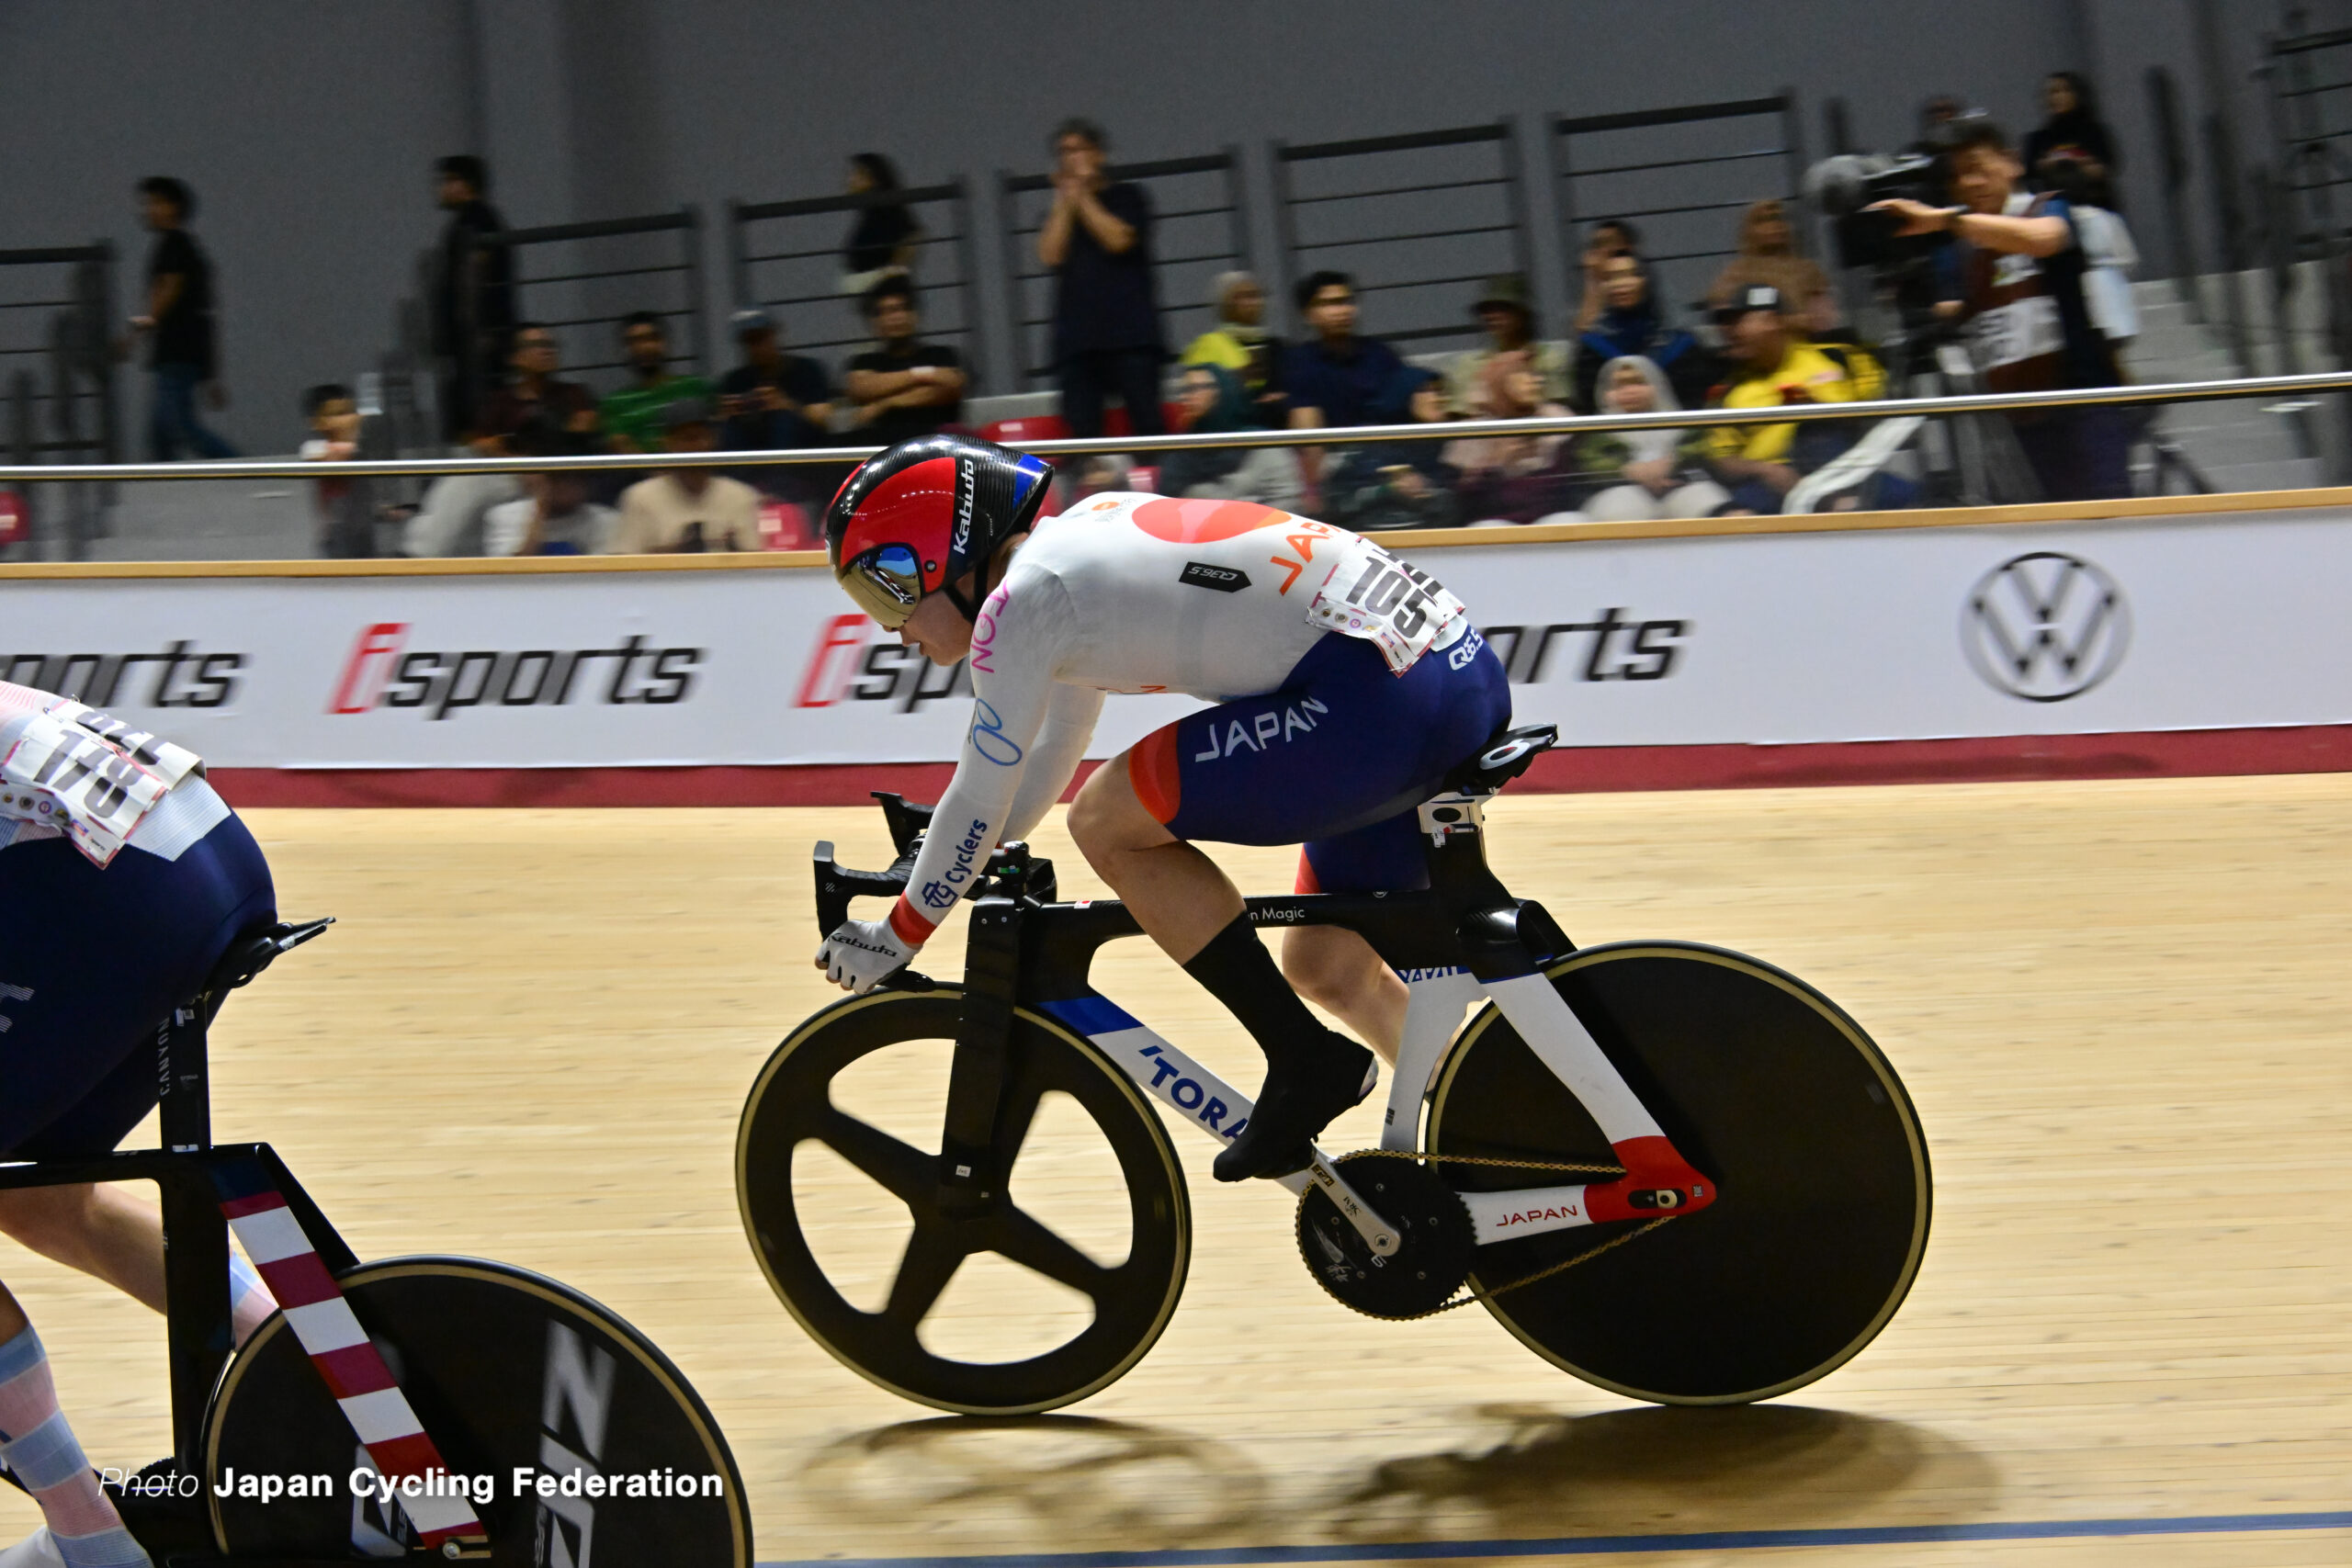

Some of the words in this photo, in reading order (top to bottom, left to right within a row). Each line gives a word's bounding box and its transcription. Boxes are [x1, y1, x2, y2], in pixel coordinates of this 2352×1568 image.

[953, 459, 974, 555] Kabuto
[1270, 520, 1343, 597] JAP
[1345, 556, 1439, 639] 105
[1194, 695, 1329, 763] JAPAN
[945, 818, 988, 884] Cyclers
[1262, 906, 1306, 922] Magic
[1496, 1204, 1577, 1227] JAPAN
